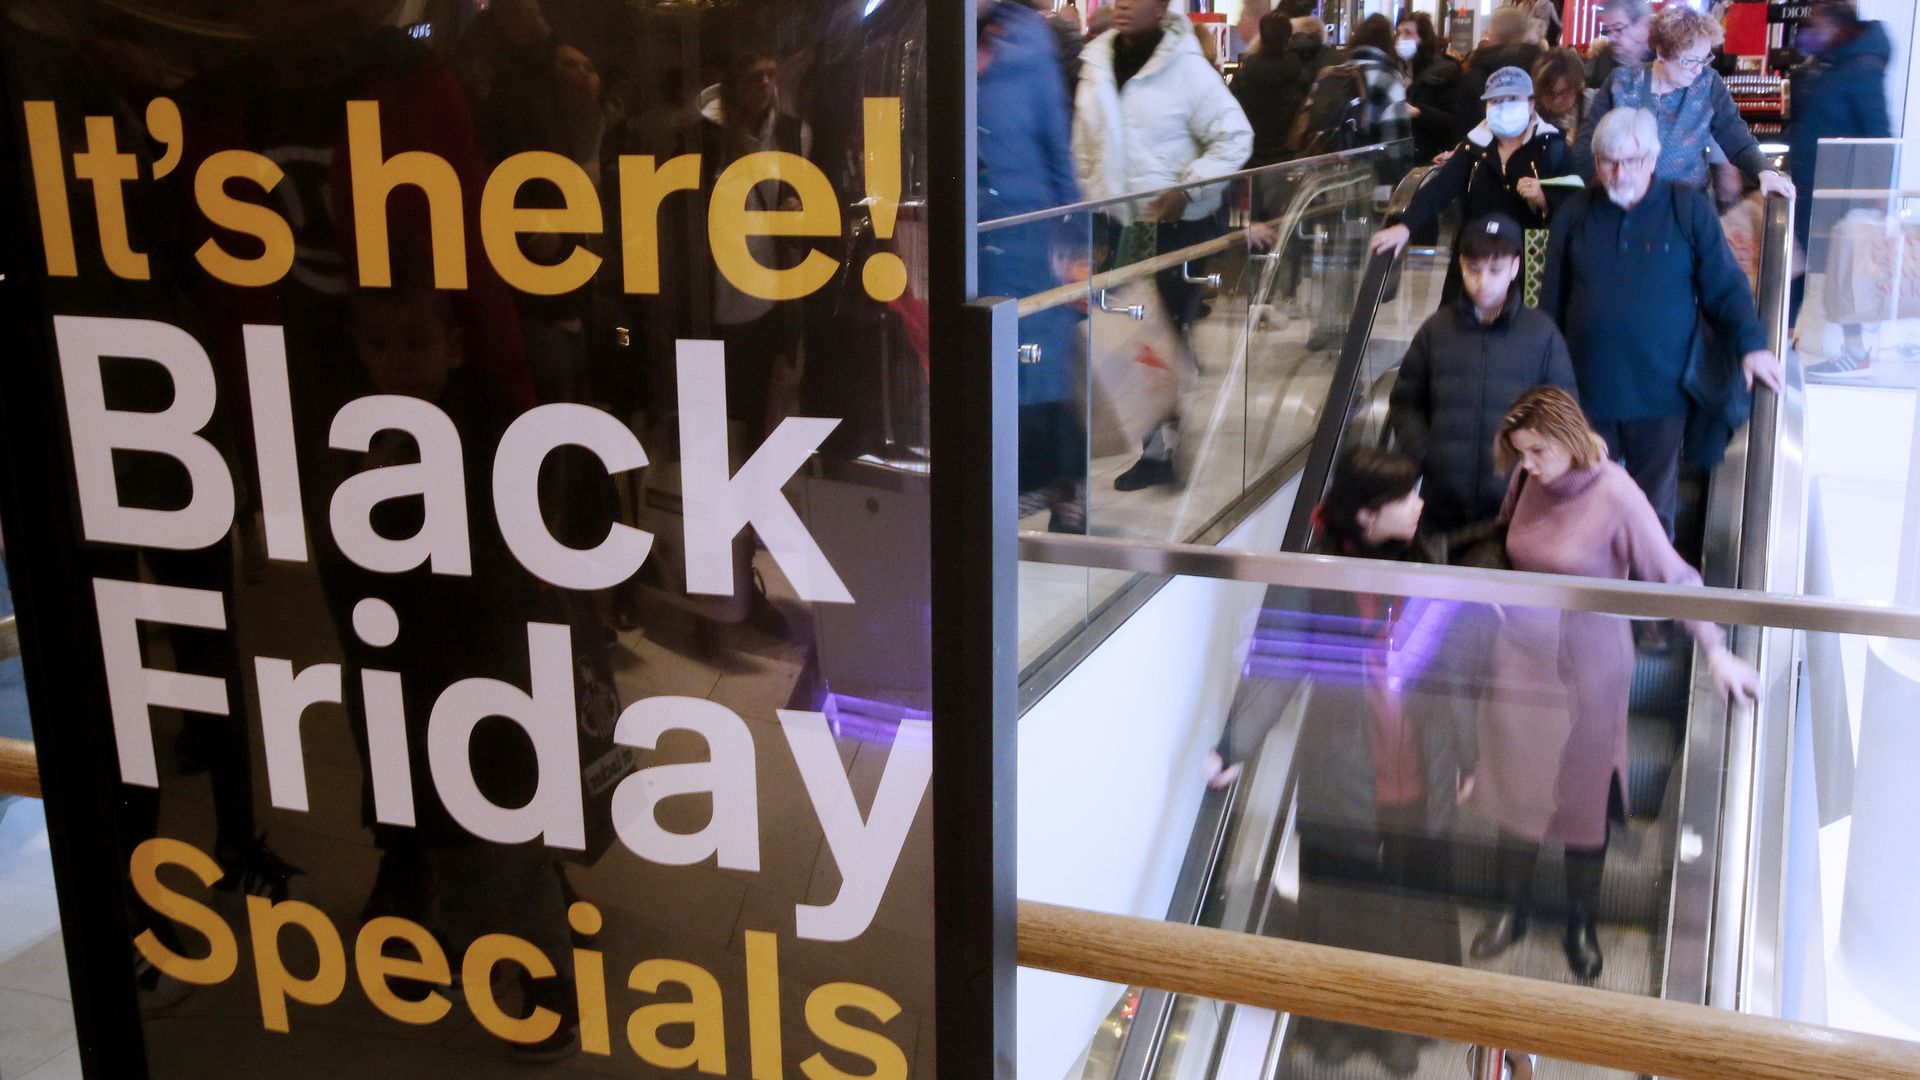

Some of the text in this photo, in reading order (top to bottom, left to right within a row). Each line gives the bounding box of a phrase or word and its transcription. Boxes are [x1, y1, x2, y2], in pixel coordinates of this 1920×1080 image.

[1782, 7, 1812, 19] DIOR
[24, 96, 908, 302] It's here!
[53, 315, 856, 605] Black
[93, 578, 934, 942] Friday
[130, 837, 909, 1080] Specials
